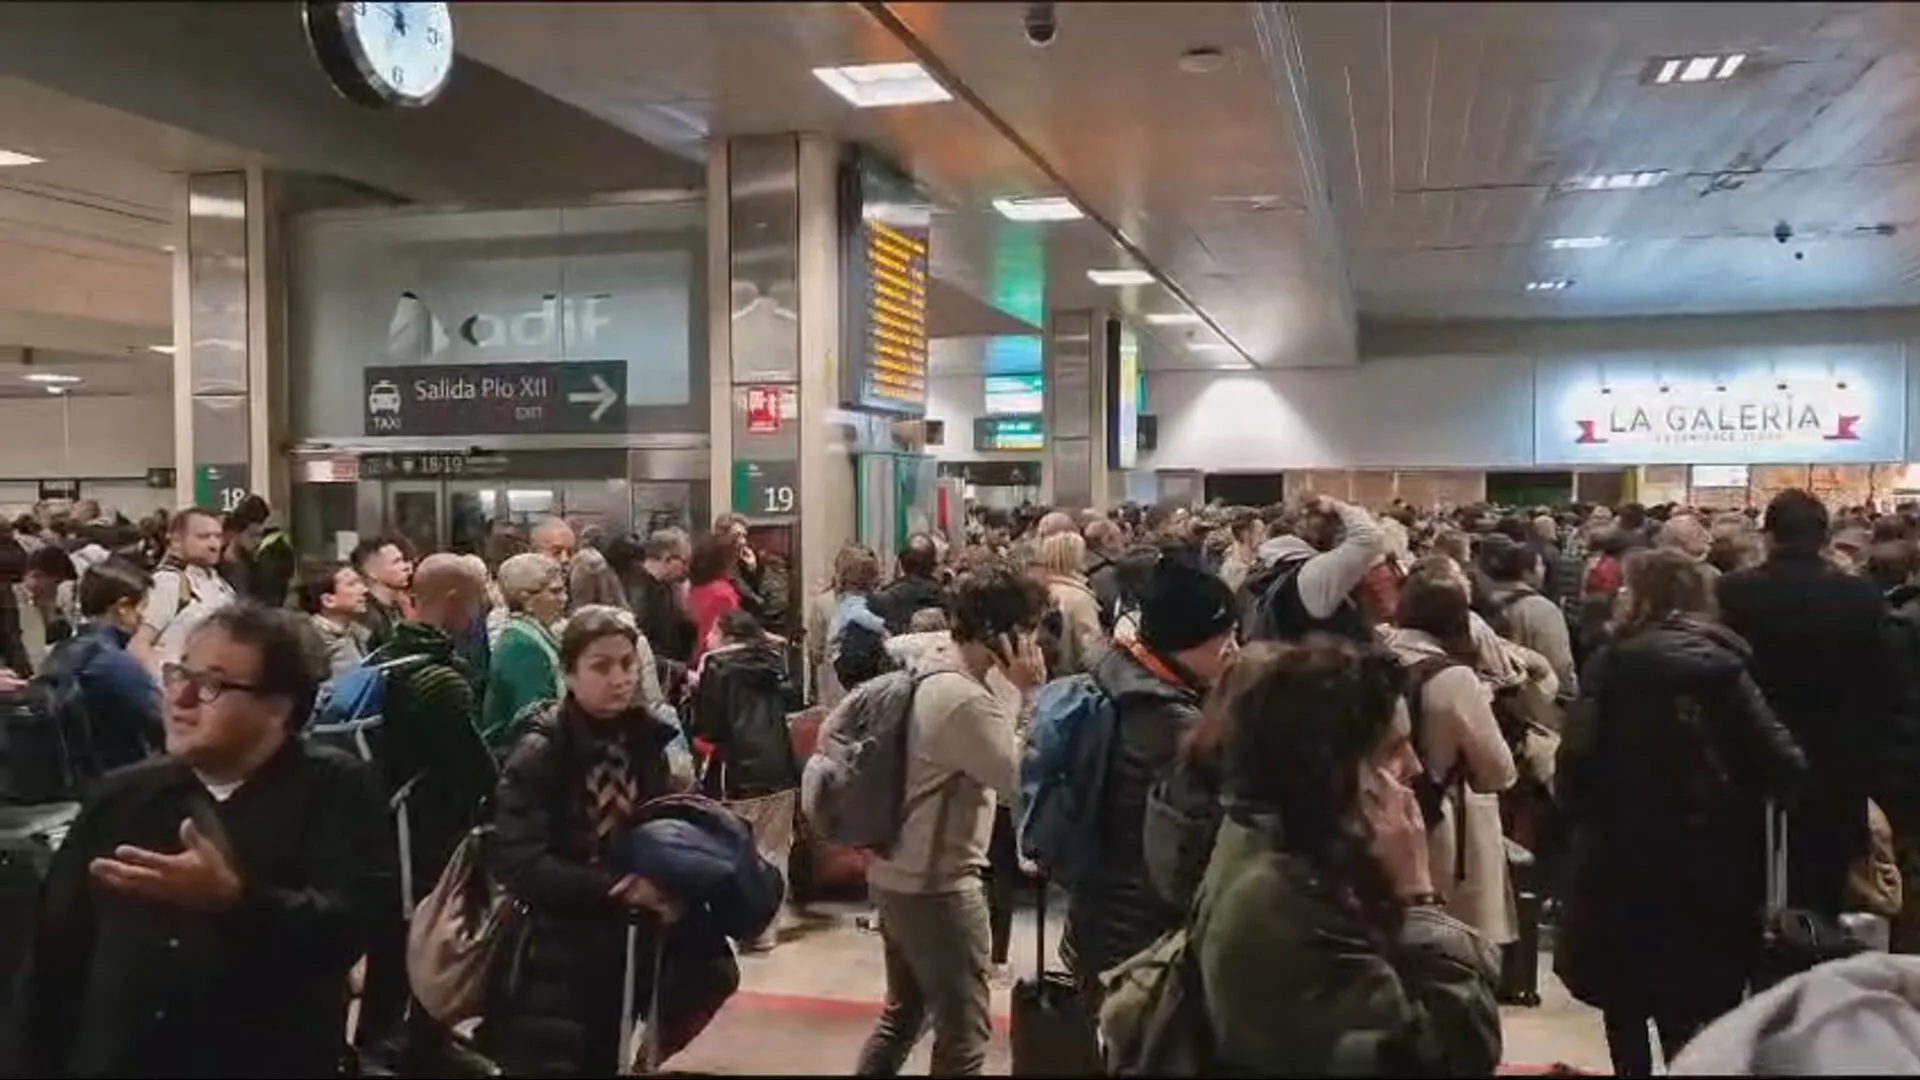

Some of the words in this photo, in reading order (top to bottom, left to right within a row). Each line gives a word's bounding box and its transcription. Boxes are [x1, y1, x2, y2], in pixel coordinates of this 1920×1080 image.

[392, 66, 404, 85] 6
[413, 376, 476, 401] Salida
[520, 376, 548, 398] XII
[373, 416, 401, 430] TAXI
[1610, 405, 1651, 432] LA
[764, 486, 794, 512] 19
